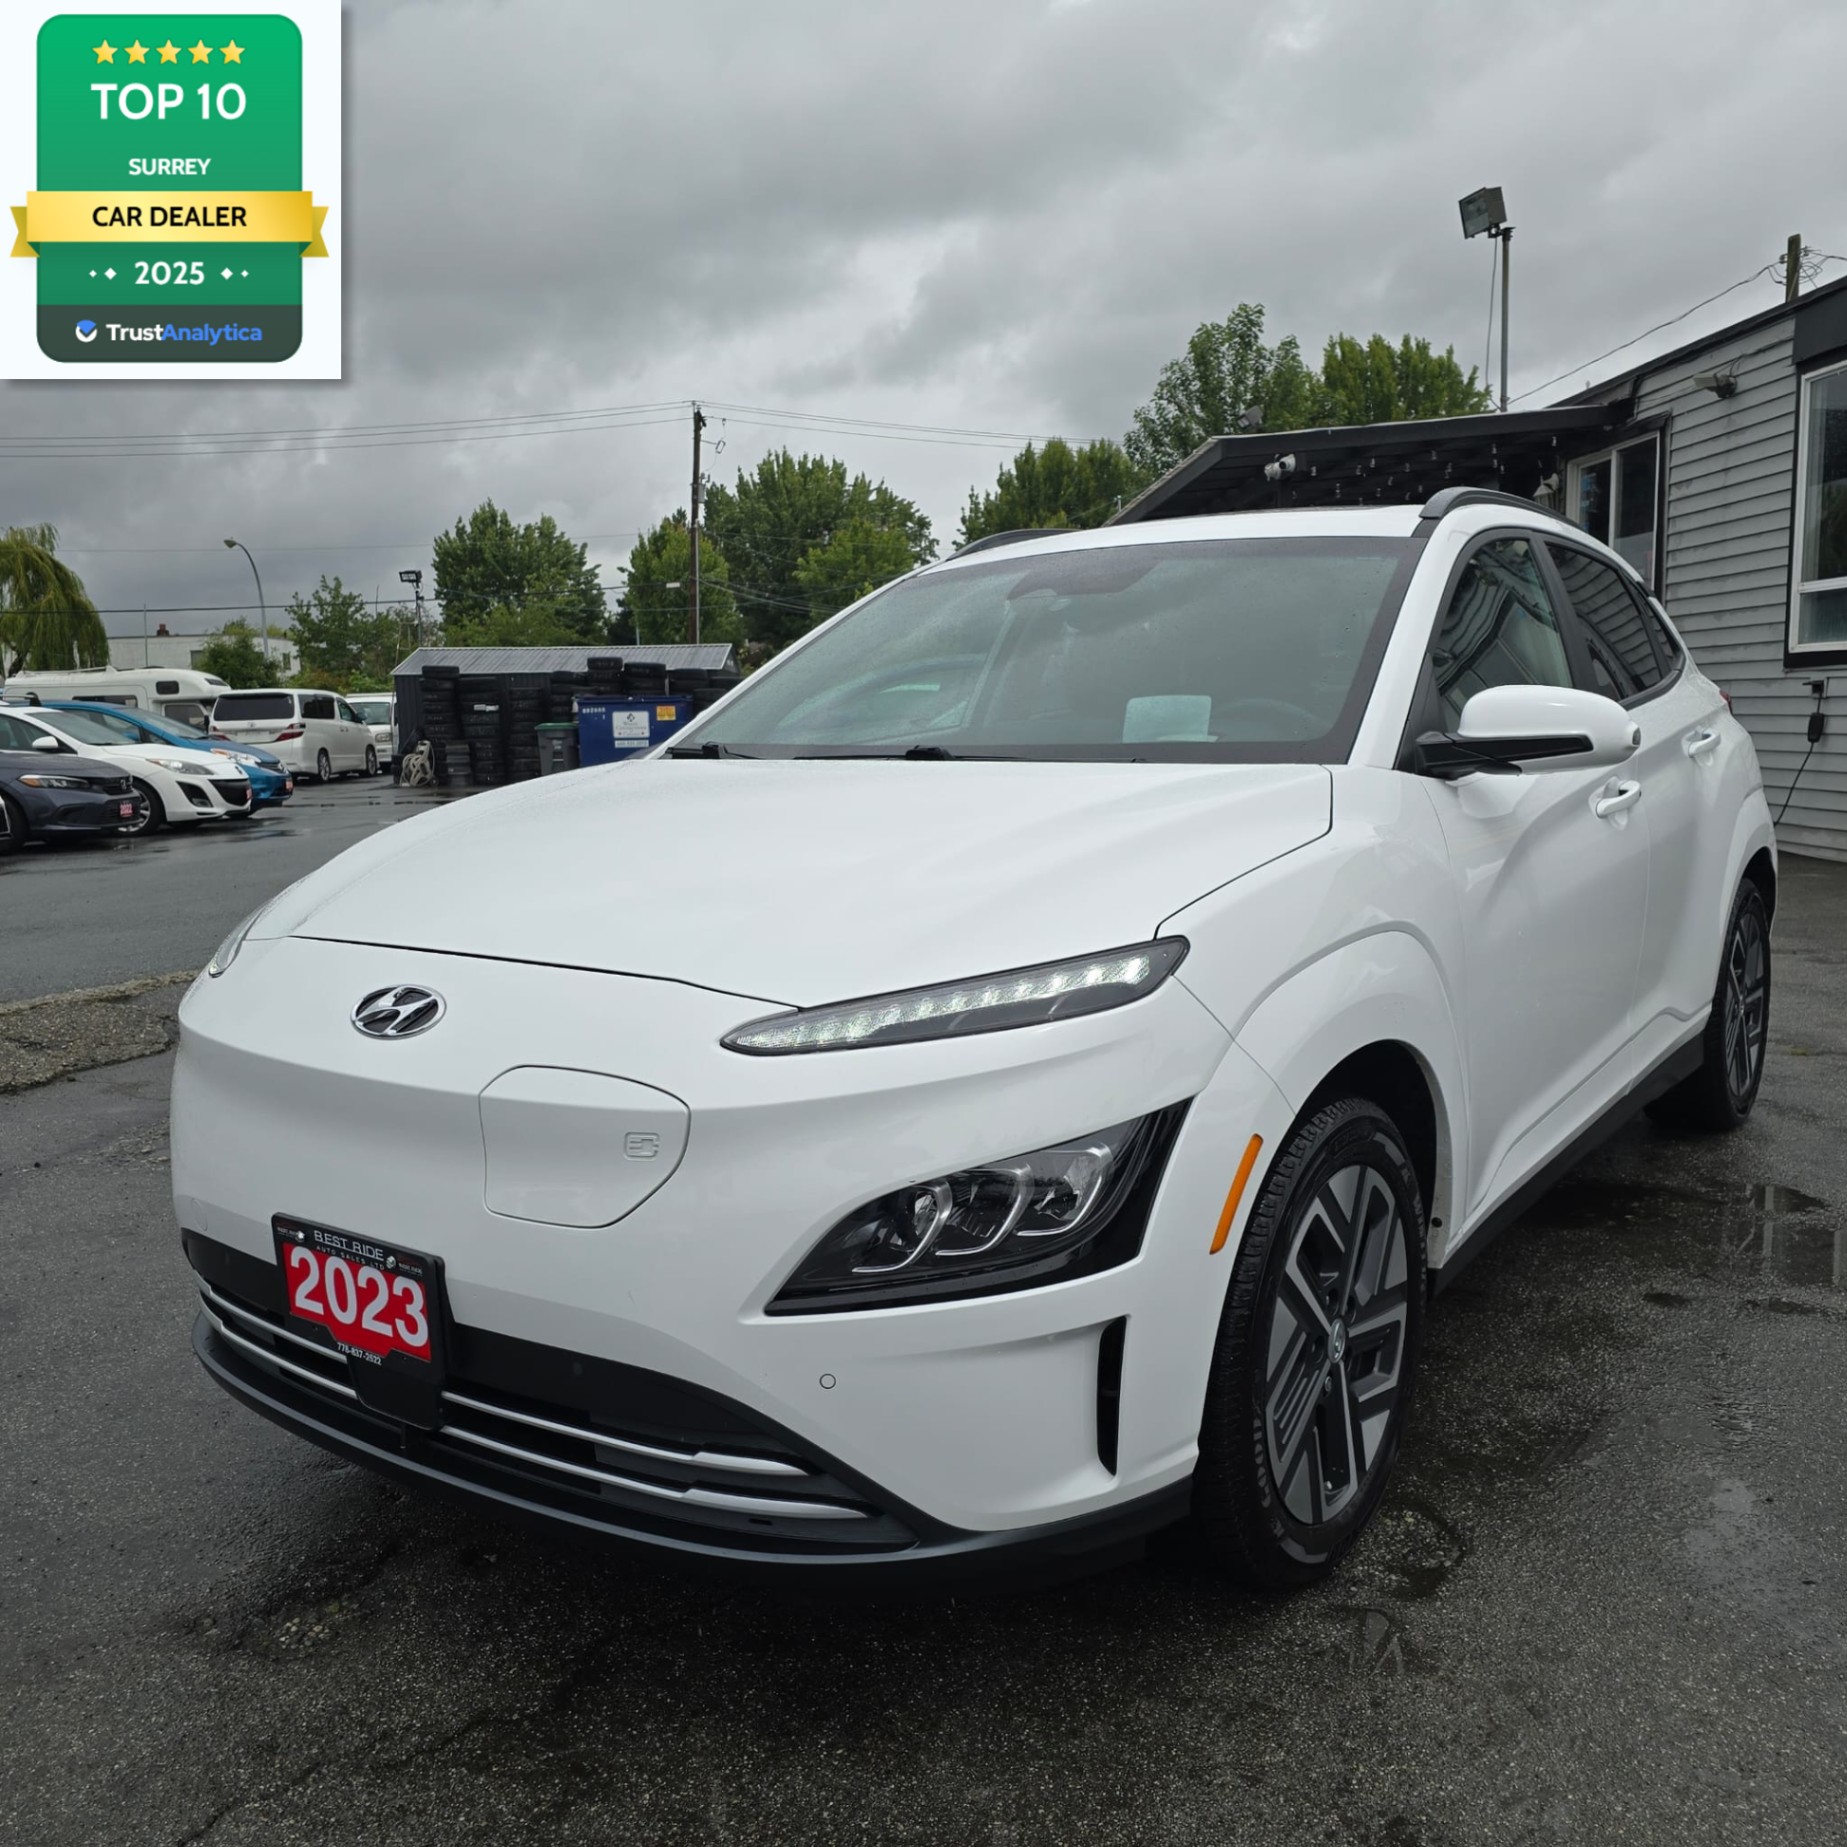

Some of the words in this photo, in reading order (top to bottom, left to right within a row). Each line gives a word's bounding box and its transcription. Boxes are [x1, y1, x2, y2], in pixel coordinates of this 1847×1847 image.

[313, 1229, 348, 1249] BEST
[352, 1241, 385, 1262] RIDE
[316, 1245, 337, 1255] AUTO
[340, 1252, 366, 1264] SALES
[370, 1261, 385, 1270] LTD
[290, 1246, 429, 1348] 2023
